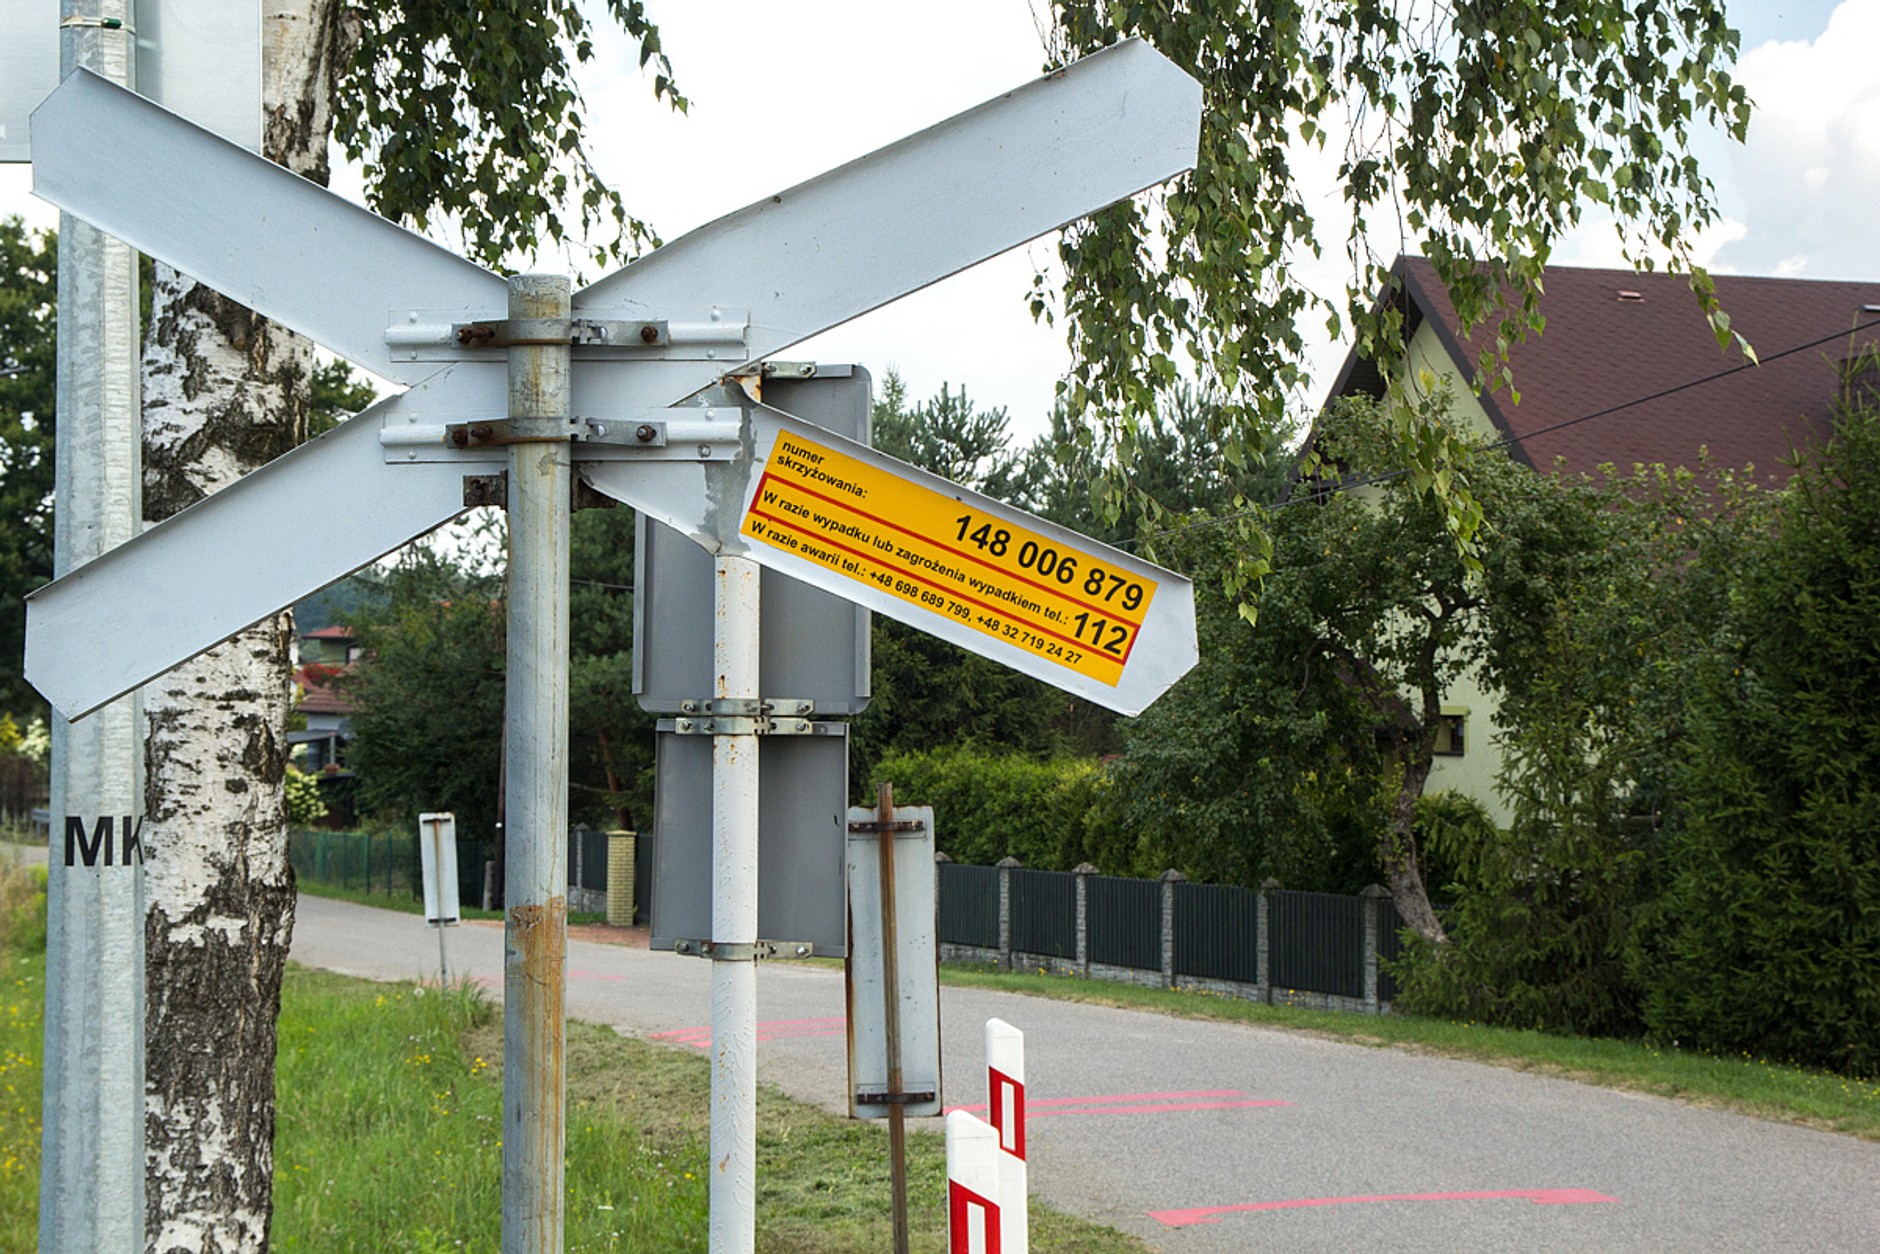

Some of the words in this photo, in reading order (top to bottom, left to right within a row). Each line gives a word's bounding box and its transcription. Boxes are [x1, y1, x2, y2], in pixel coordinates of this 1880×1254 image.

[777, 454, 868, 499] skrzyżowania:
[782, 442, 825, 466] numer
[751, 520, 767, 535] W
[767, 527, 798, 548] razie
[800, 541, 841, 566] awarii
[841, 558, 866, 577] tel.:
[870, 571, 893, 587] +48
[895, 580, 919, 598] 698
[921, 591, 945, 609] 689
[947, 600, 972, 623] 799,
[976, 615, 1000, 632] +48
[1002, 624, 1019, 639] 32
[1021, 632, 1046, 650] 719
[1046, 642, 1063, 657] 24
[1065, 650, 1082, 664] 27
[764, 490, 778, 505] W
[778, 495, 810, 518] razie
[813, 512, 871, 544] wypadku
[872, 535, 894, 553] lub
[896, 547, 965, 582] zagrożenia
[969, 576, 1041, 615] wypadkiem
[1043, 606, 1069, 625] tel.:
[1074, 612, 1128, 655] 112
[956, 515, 1011, 557] 148
[1018, 541, 1078, 584] 006
[1083, 568, 1144, 611] 879
